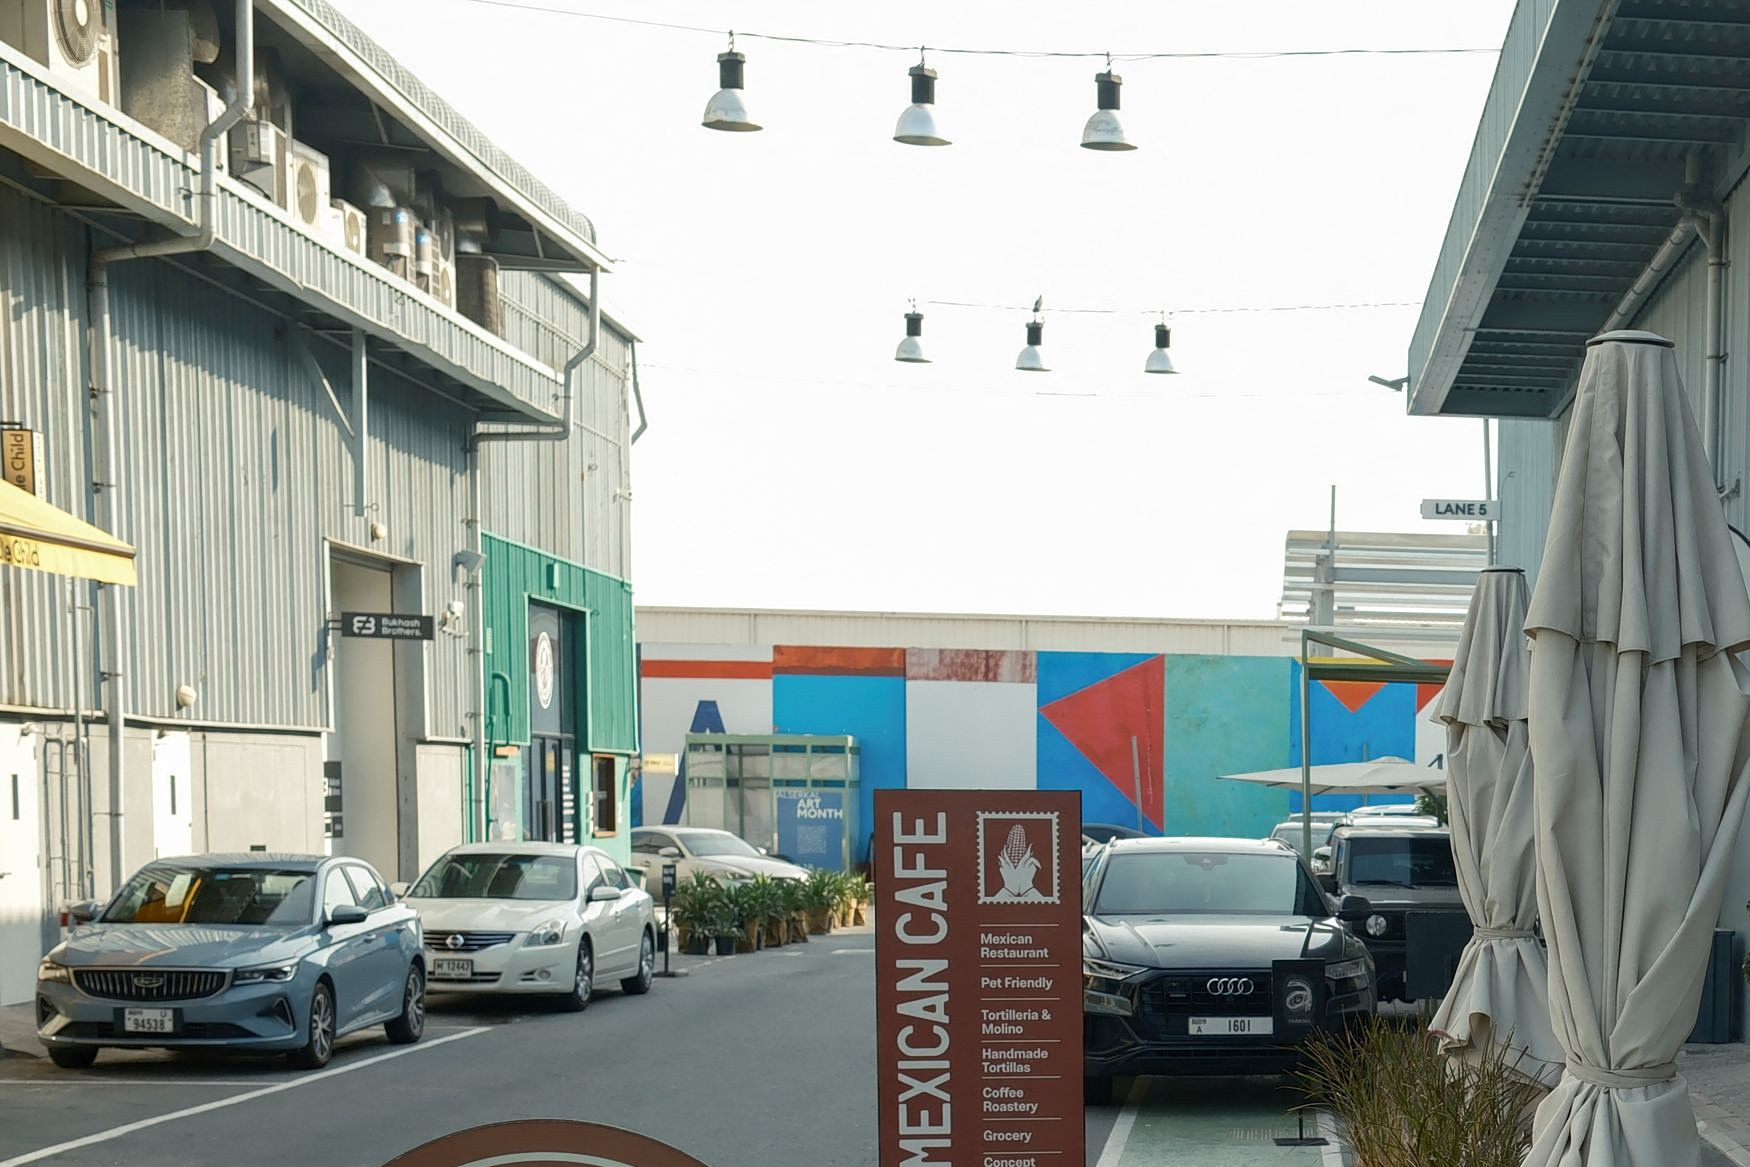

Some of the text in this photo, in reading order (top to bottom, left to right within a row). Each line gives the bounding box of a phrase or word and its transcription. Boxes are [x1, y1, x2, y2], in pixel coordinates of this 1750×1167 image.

[11, 433, 26, 472] Child
[1435, 502, 1487, 516] LANE 5
[381, 617, 420, 628] Bukhash
[797, 798, 822, 809] ART
[797, 808, 844, 819] MONTH
[893, 811, 949, 944] CAFE
[980, 933, 1033, 945] Mexican
[980, 946, 1049, 959] Restaurant
[981, 976, 1053, 991] Pet Friendly
[981, 1009, 1051, 1021] Tortilleria &
[982, 1022, 1024, 1035] Molino
[1228, 1019, 1251, 1033] 1601
[982, 1048, 1049, 1060] Handmade
[982, 1061, 1031, 1073] Tortillas
[983, 1087, 1024, 1099] Coffee
[983, 1100, 1038, 1114] Roastery
[983, 1130, 1032, 1143] Grocery
